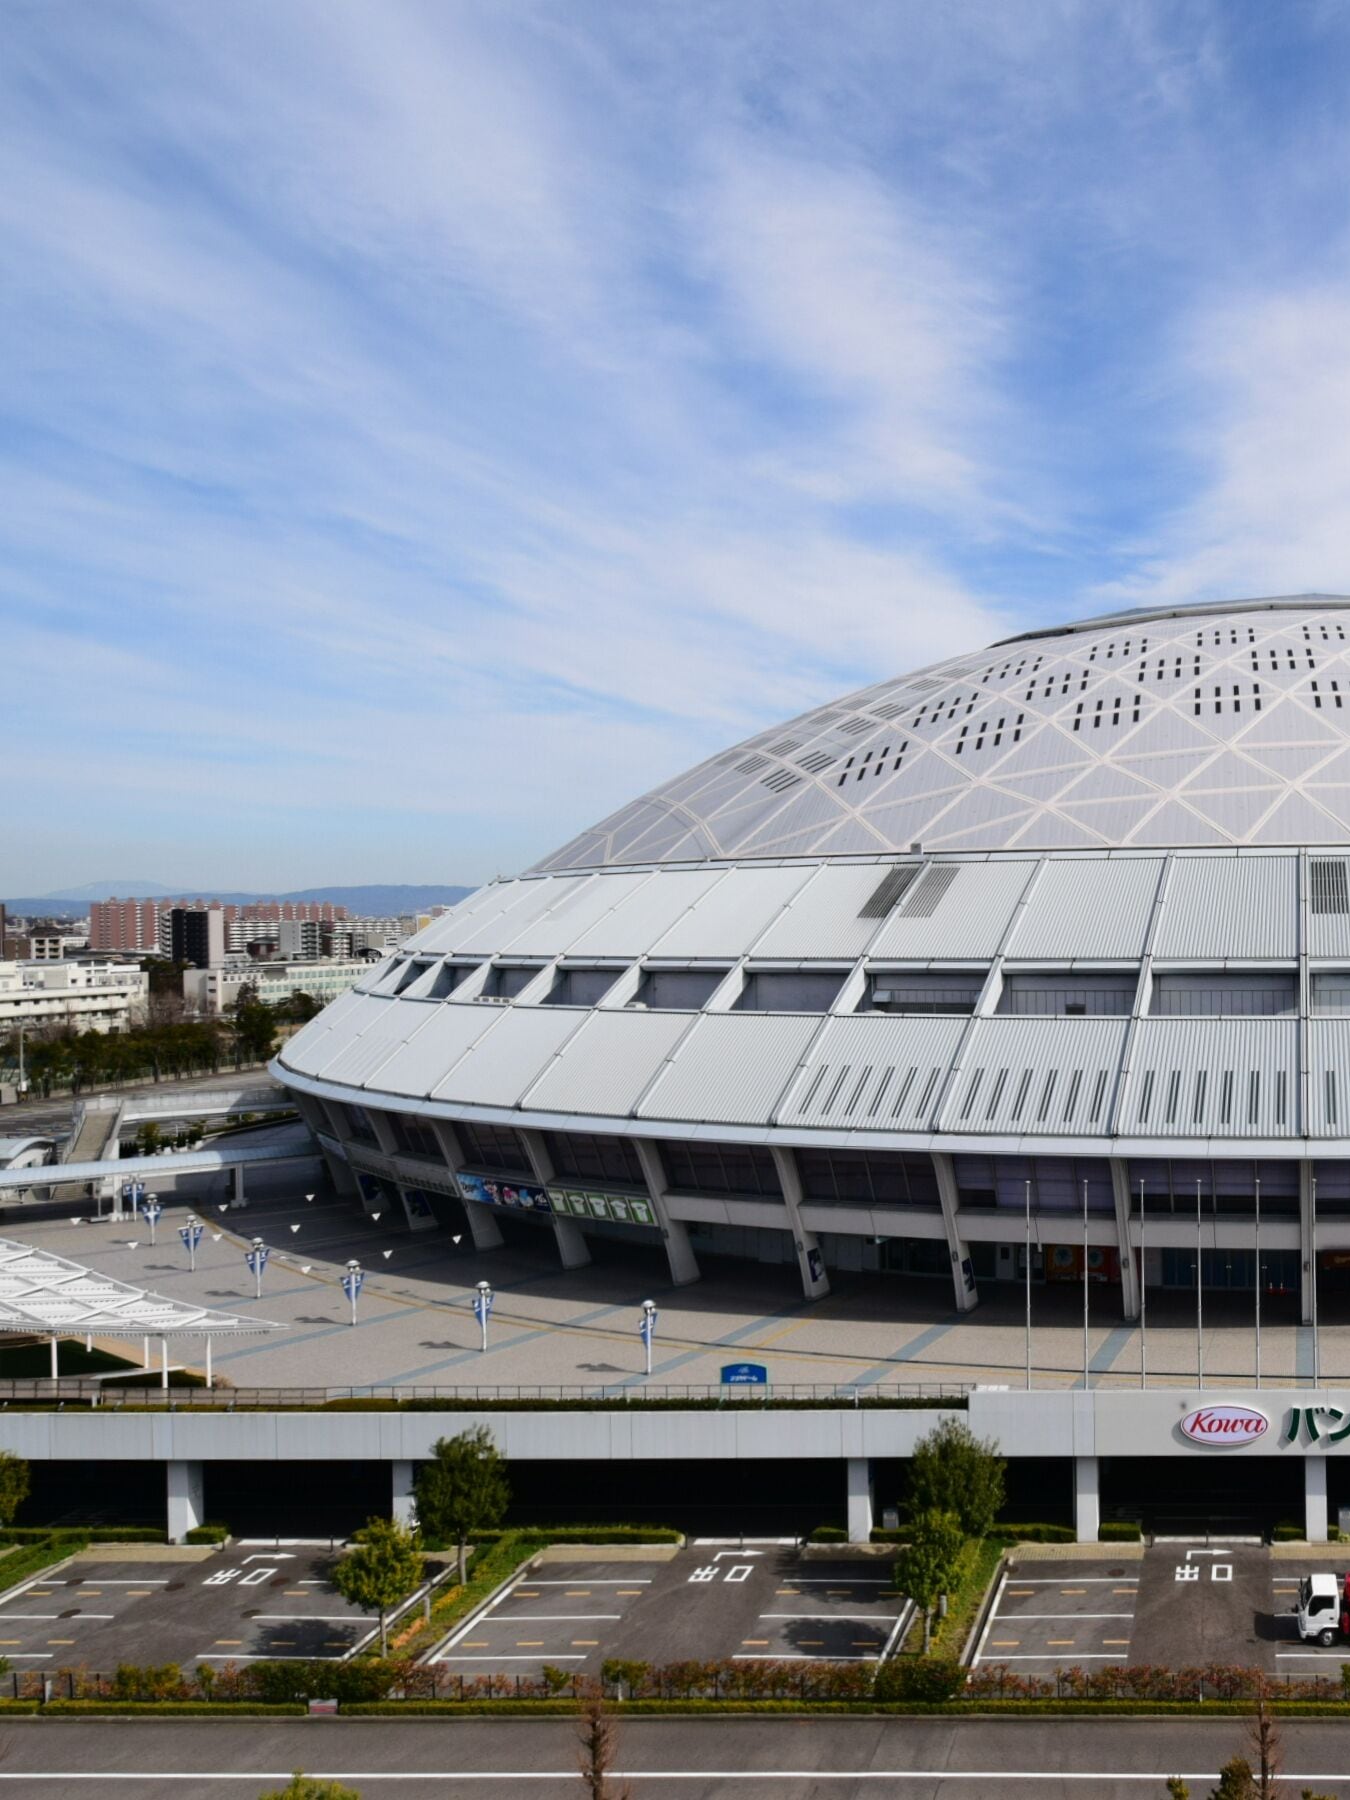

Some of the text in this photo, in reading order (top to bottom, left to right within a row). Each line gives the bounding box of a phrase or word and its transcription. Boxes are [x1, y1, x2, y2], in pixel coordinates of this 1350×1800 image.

[1189, 1411, 1264, 1434] Kowa
[201, 1568, 279, 1585] 出口
[687, 1565, 754, 1582] 出口
[1174, 1564, 1233, 1581] 出口
